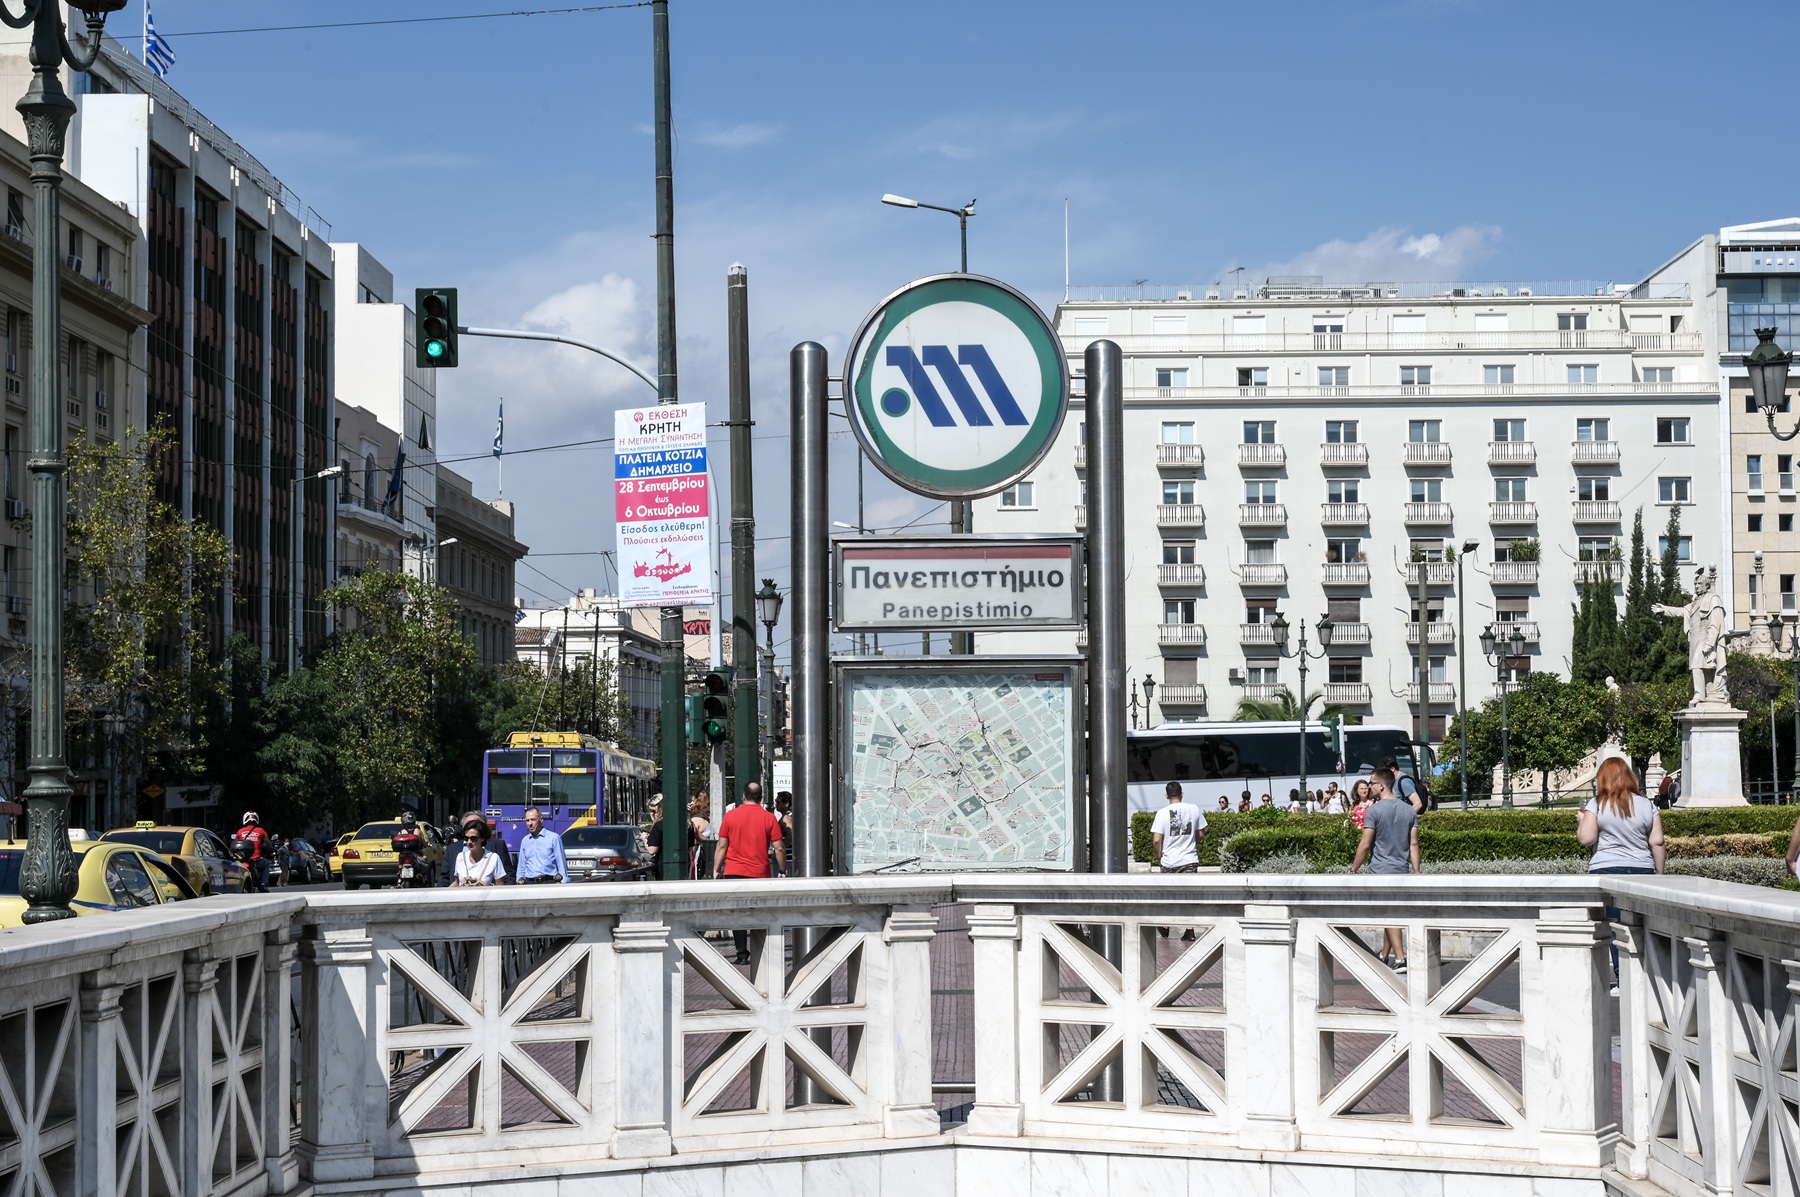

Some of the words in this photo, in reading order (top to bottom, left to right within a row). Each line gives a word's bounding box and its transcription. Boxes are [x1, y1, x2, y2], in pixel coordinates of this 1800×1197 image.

[649, 409, 687, 421] ΕΚΘΕΣΗ
[639, 421, 681, 435] ΚΡΗΤΗ
[619, 438, 625, 446] Η
[628, 436, 658, 445] ΜΕΓΑΛΗ
[661, 433, 702, 443] ΣΥΝΑΝΤΗΣΗ
[619, 453, 662, 465] ΠΛΑΤΕΙΑ
[665, 449, 703, 461] ΚΟΤΖΙΑ
[629, 463, 692, 477] ΔΗΜΑΡΧΕΙΟ
[619, 482, 634, 494] 28
[637, 477, 705, 493] Σεπτεμβρίου
[655, 495, 669, 503] έως
[625, 506, 633, 518] 6
[636, 502, 700, 518] Οκτωβρίου
[621, 525, 658, 534] Είσοδος
[660, 521, 705, 532] ελεύθερη!
[623, 536, 658, 545] Πλούσιες
[851, 565, 1064, 592] Πανεπιστήμιο
[882, 601, 1033, 621] Panepistimio
